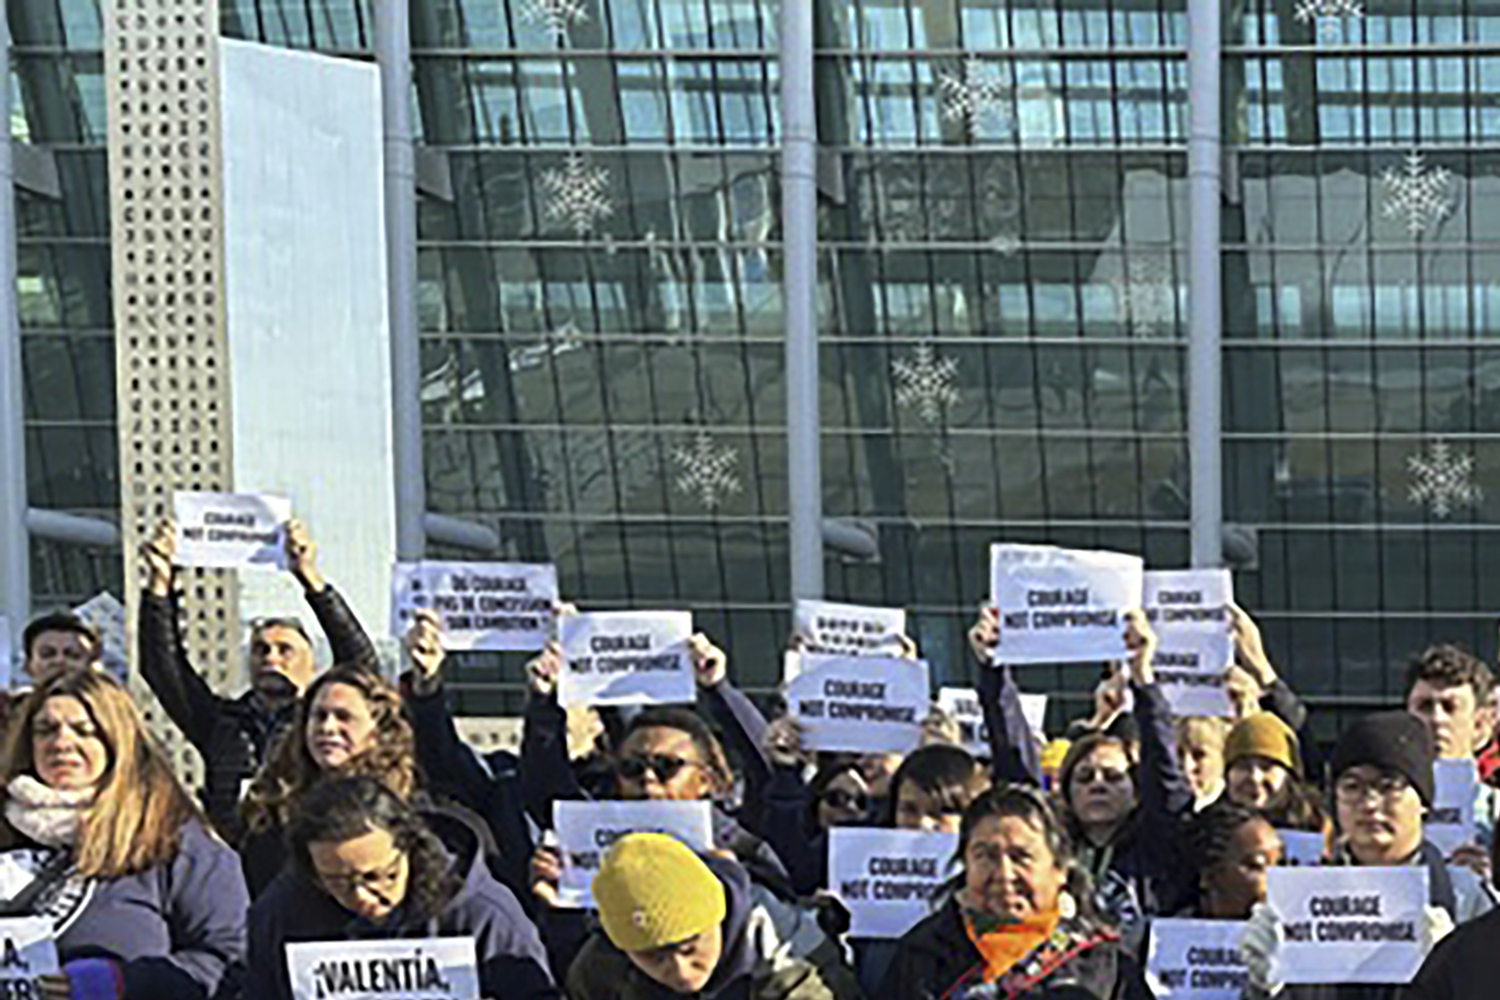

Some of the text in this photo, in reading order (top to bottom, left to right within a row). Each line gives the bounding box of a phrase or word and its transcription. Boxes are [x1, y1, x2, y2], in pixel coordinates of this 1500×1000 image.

[1028, 588, 1088, 607] COURAGE
[1005, 610, 1117, 629] NOT COMPROMISE
[824, 679, 886, 698] COURAGE
[800, 701, 915, 722] NOT COMPROMISE
[869, 857, 937, 878] COURAGE
[841, 879, 869, 900] NOT
[1310, 895, 1381, 917] COURAGE
[1284, 921, 1417, 942] NOT COMPROMISE
